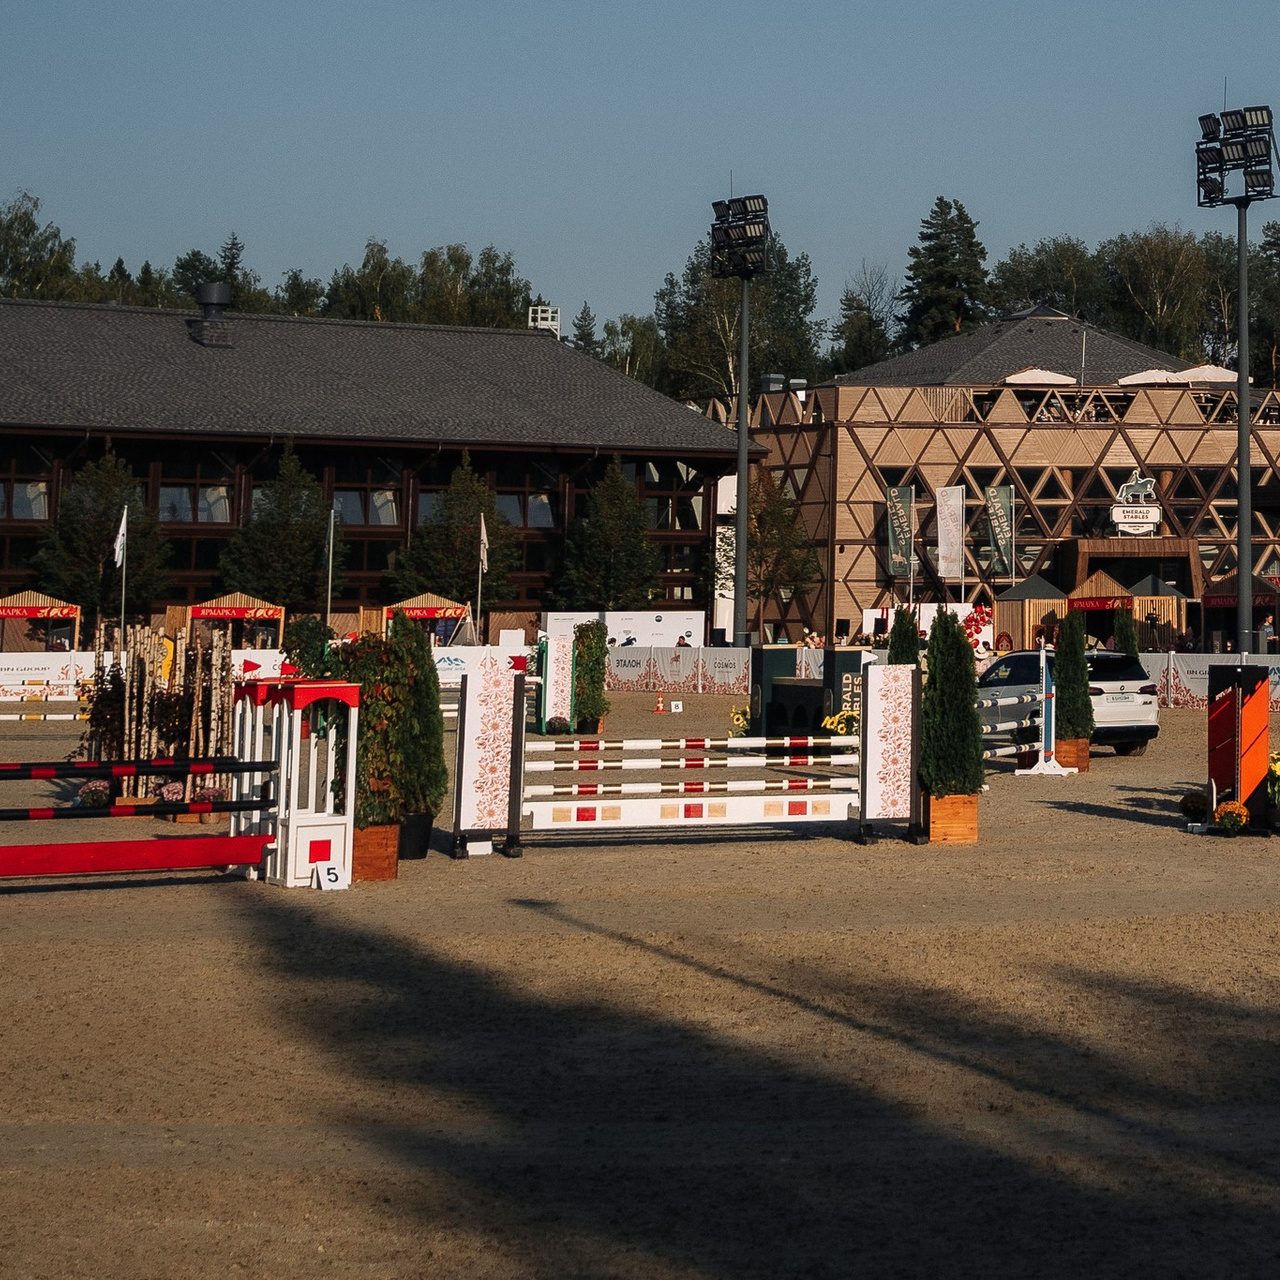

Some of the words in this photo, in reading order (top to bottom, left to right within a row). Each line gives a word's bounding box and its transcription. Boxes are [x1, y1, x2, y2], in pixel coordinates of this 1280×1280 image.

[1073, 600, 1100, 608] ЯРМАРКА
[0, 608, 28, 616] МАРКА
[615, 659, 641, 669] ЭТАЛОН
[713, 661, 737, 669] COSMOS
[842, 673, 853, 712] RALD
[326, 867, 339, 883] 5
